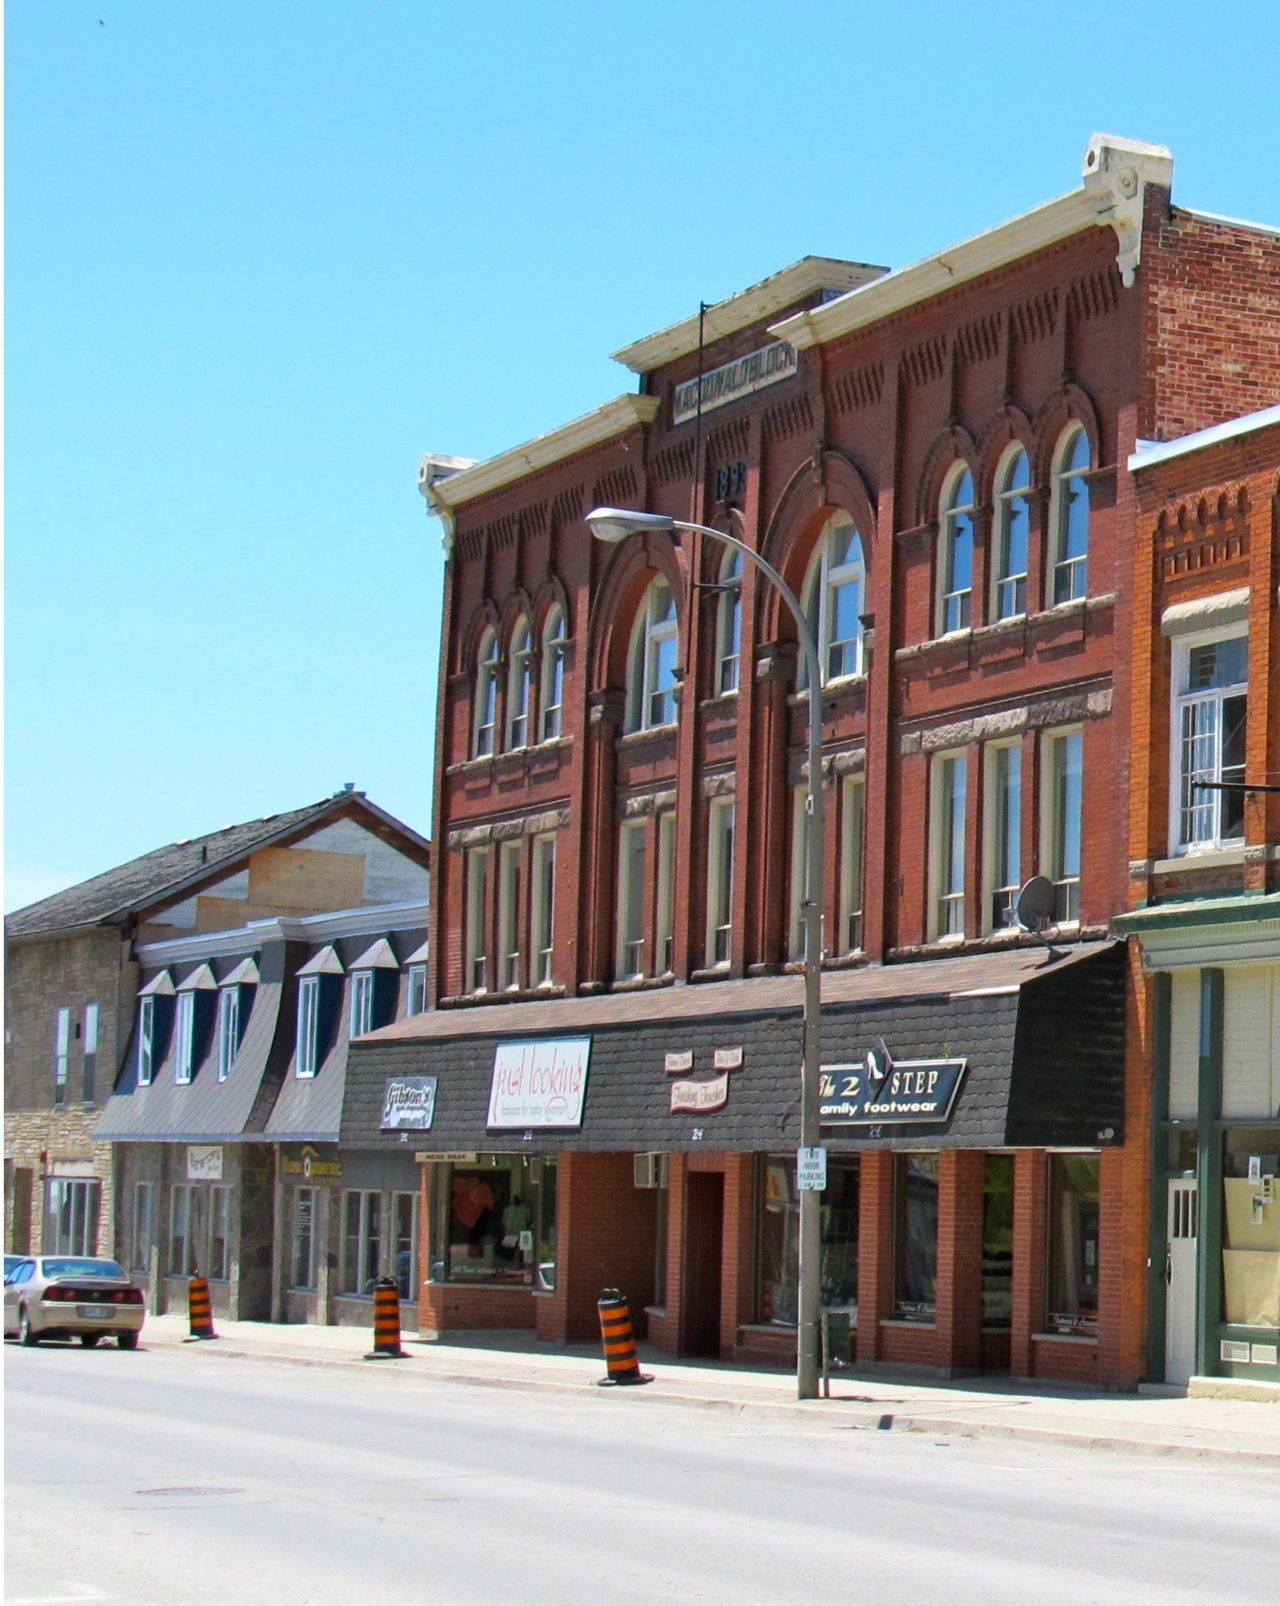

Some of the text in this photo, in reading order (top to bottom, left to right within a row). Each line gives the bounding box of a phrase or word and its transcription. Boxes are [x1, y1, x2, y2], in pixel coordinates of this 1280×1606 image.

[528, 1044, 582, 1122] looking
[840, 1076, 861, 1097] 2
[890, 1070, 939, 1095] STEP
[820, 1100, 938, 1116] amily footwear
[805, 1150, 819, 1159] TWO
